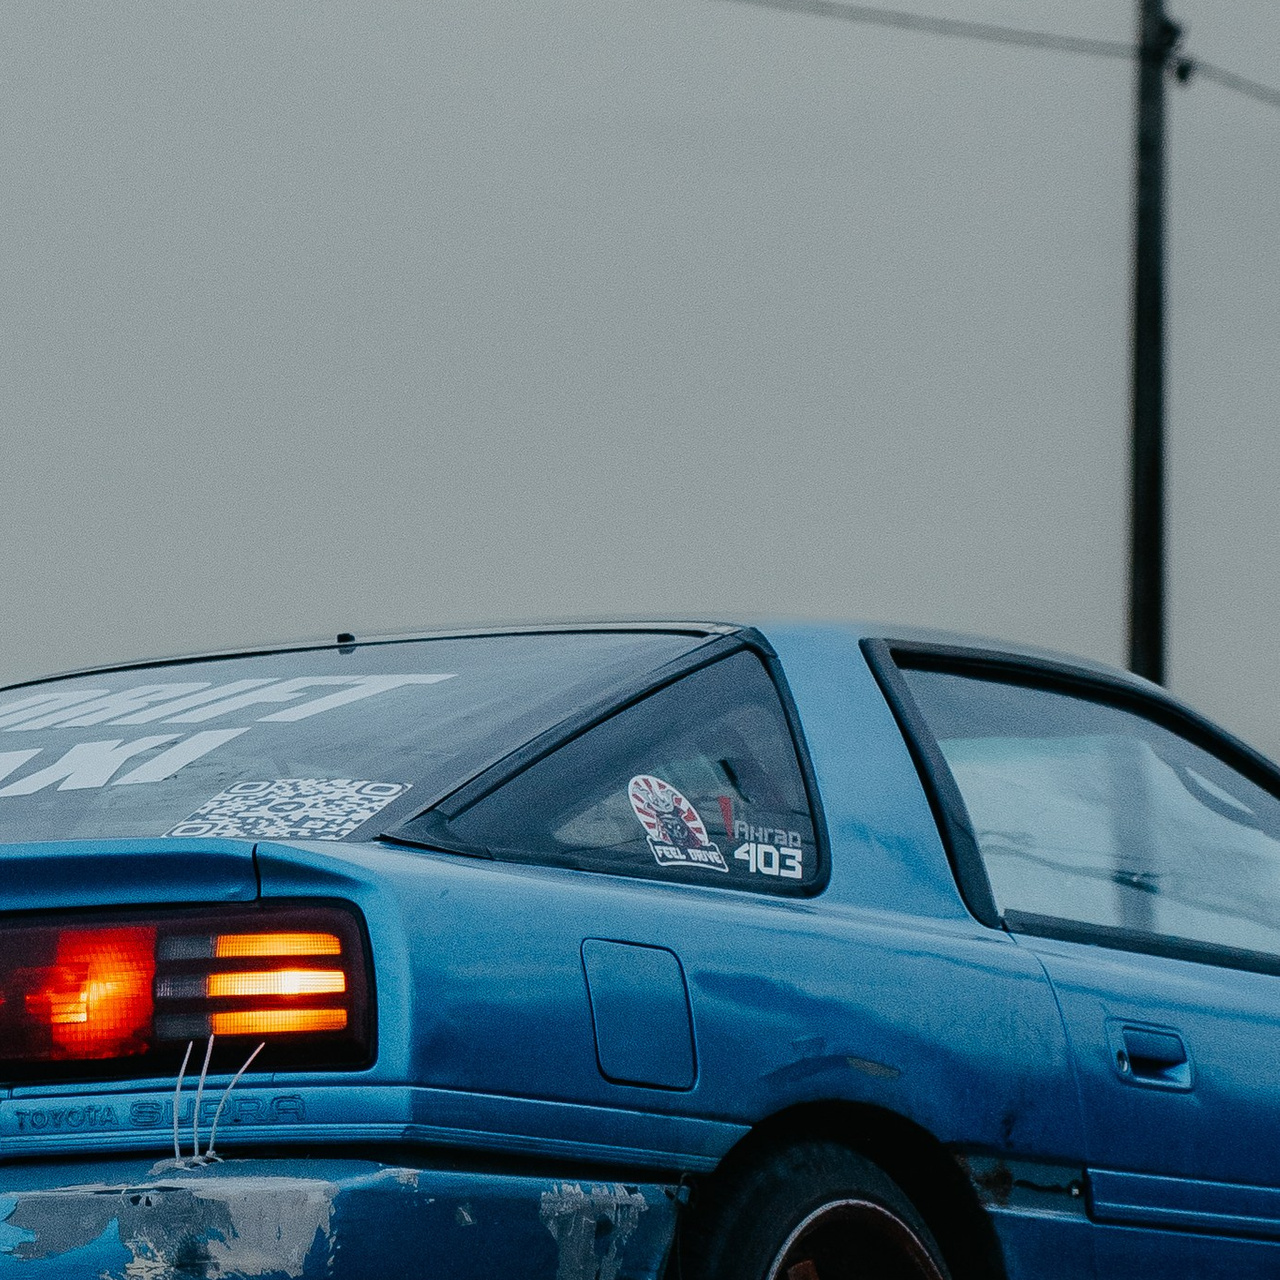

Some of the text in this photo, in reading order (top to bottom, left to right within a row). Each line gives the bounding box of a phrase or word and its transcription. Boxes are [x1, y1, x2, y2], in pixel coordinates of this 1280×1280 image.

[656, 845, 724, 865] FEEL DRIVE
[733, 842, 803, 879] 403
[14, 1094, 307, 1130] TOYOTA SUPRA
